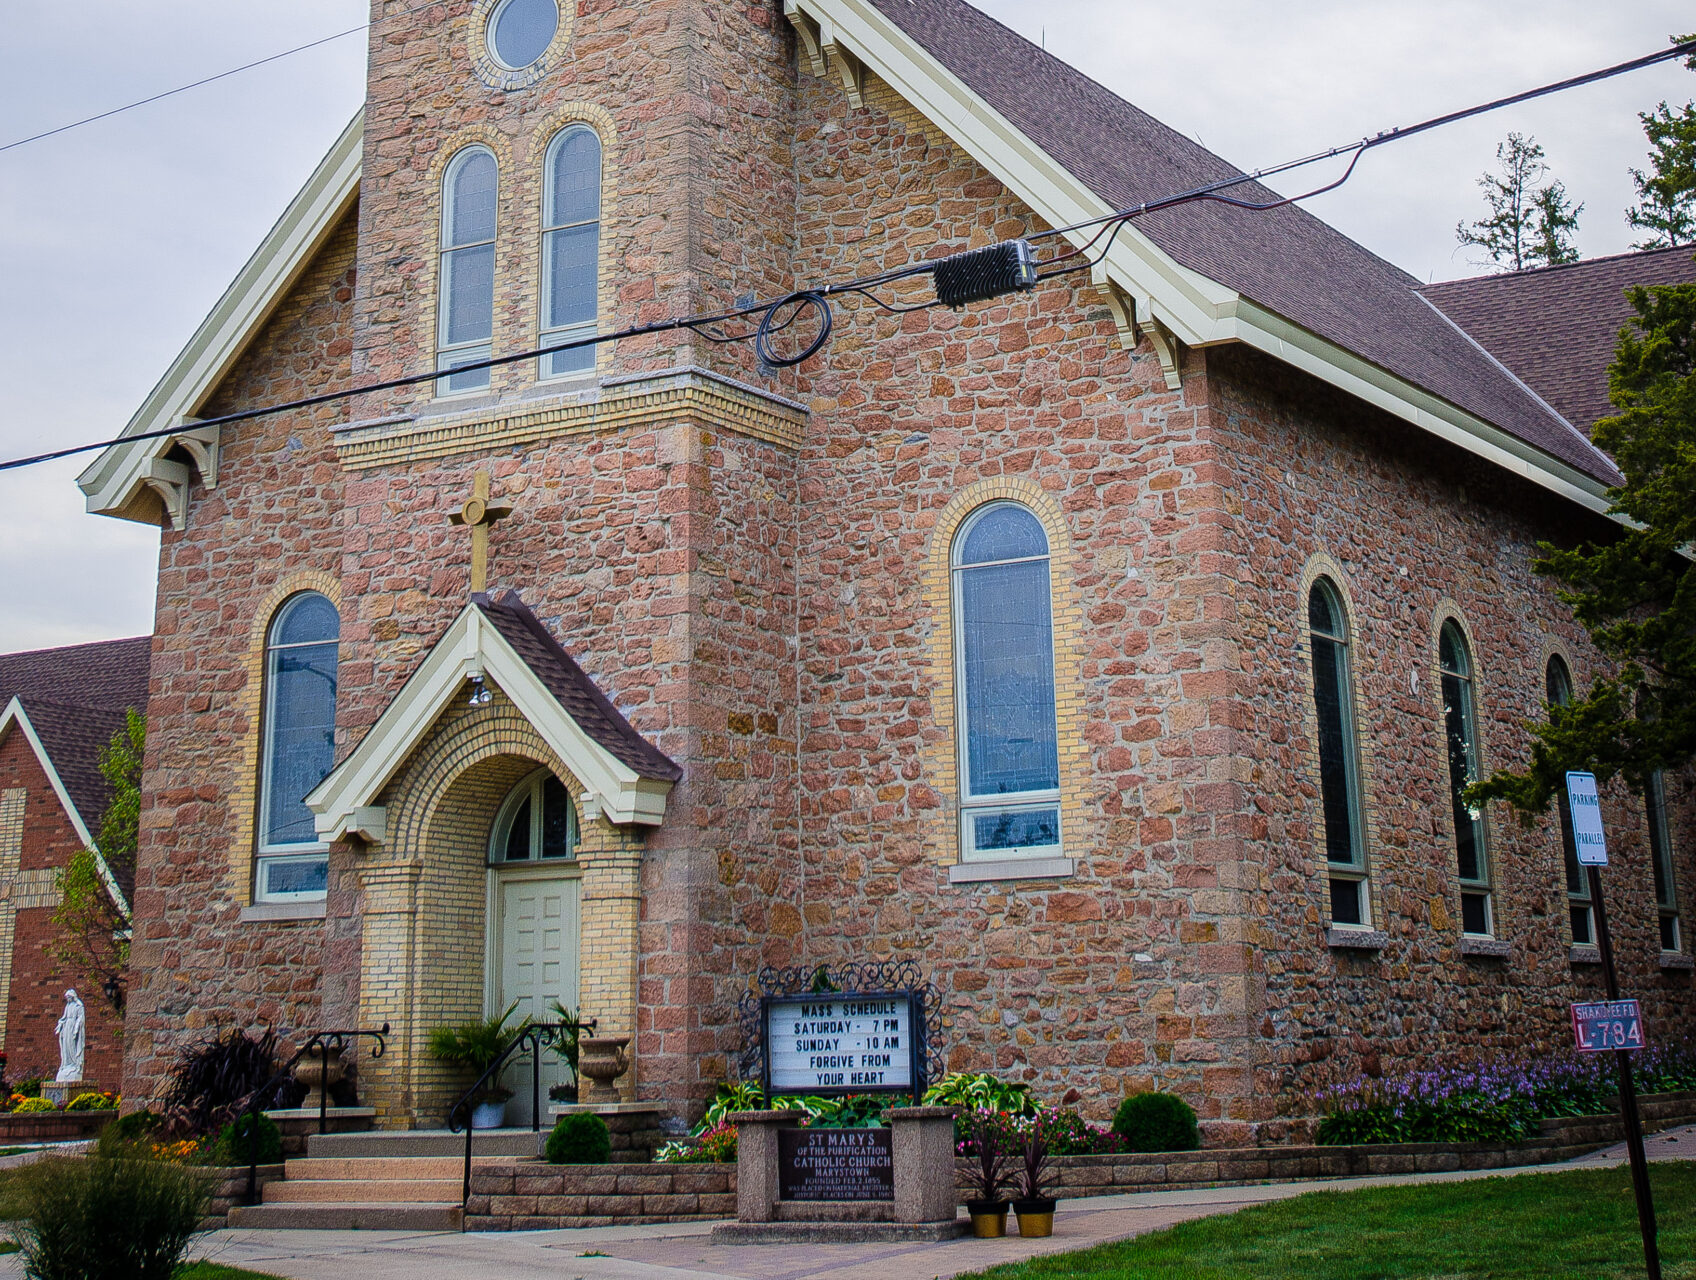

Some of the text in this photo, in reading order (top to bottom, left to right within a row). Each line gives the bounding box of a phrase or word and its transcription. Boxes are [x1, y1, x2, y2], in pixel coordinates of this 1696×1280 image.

[1573, 793, 1598, 806] PARKING
[1578, 832, 1603, 845] PARALLEL
[801, 1002, 896, 1018] MASS SCHEDULE
[794, 1021, 851, 1035] SATURDAY
[873, 1020, 879, 1032] 7
[884, 1019, 898, 1032] PM
[1577, 1020, 1641, 1048] L-784
[796, 1038, 839, 1052] SUNDAY
[866, 1037, 878, 1049] 10
[884, 1036, 899, 1049] AM
[810, 1054, 891, 1068] FORGIVE FROM
[817, 1071, 884, 1086] YOUR HEART
[809, 1132, 875, 1146] ST MARY'S
[797, 1146, 887, 1156] OF THE PURIFICATION
[793, 1156, 891, 1168] CATHOLIC CHURCH
[815, 1168, 870, 1177] MARYSTOWN
[805, 1177, 841, 1185] FOUNDED
